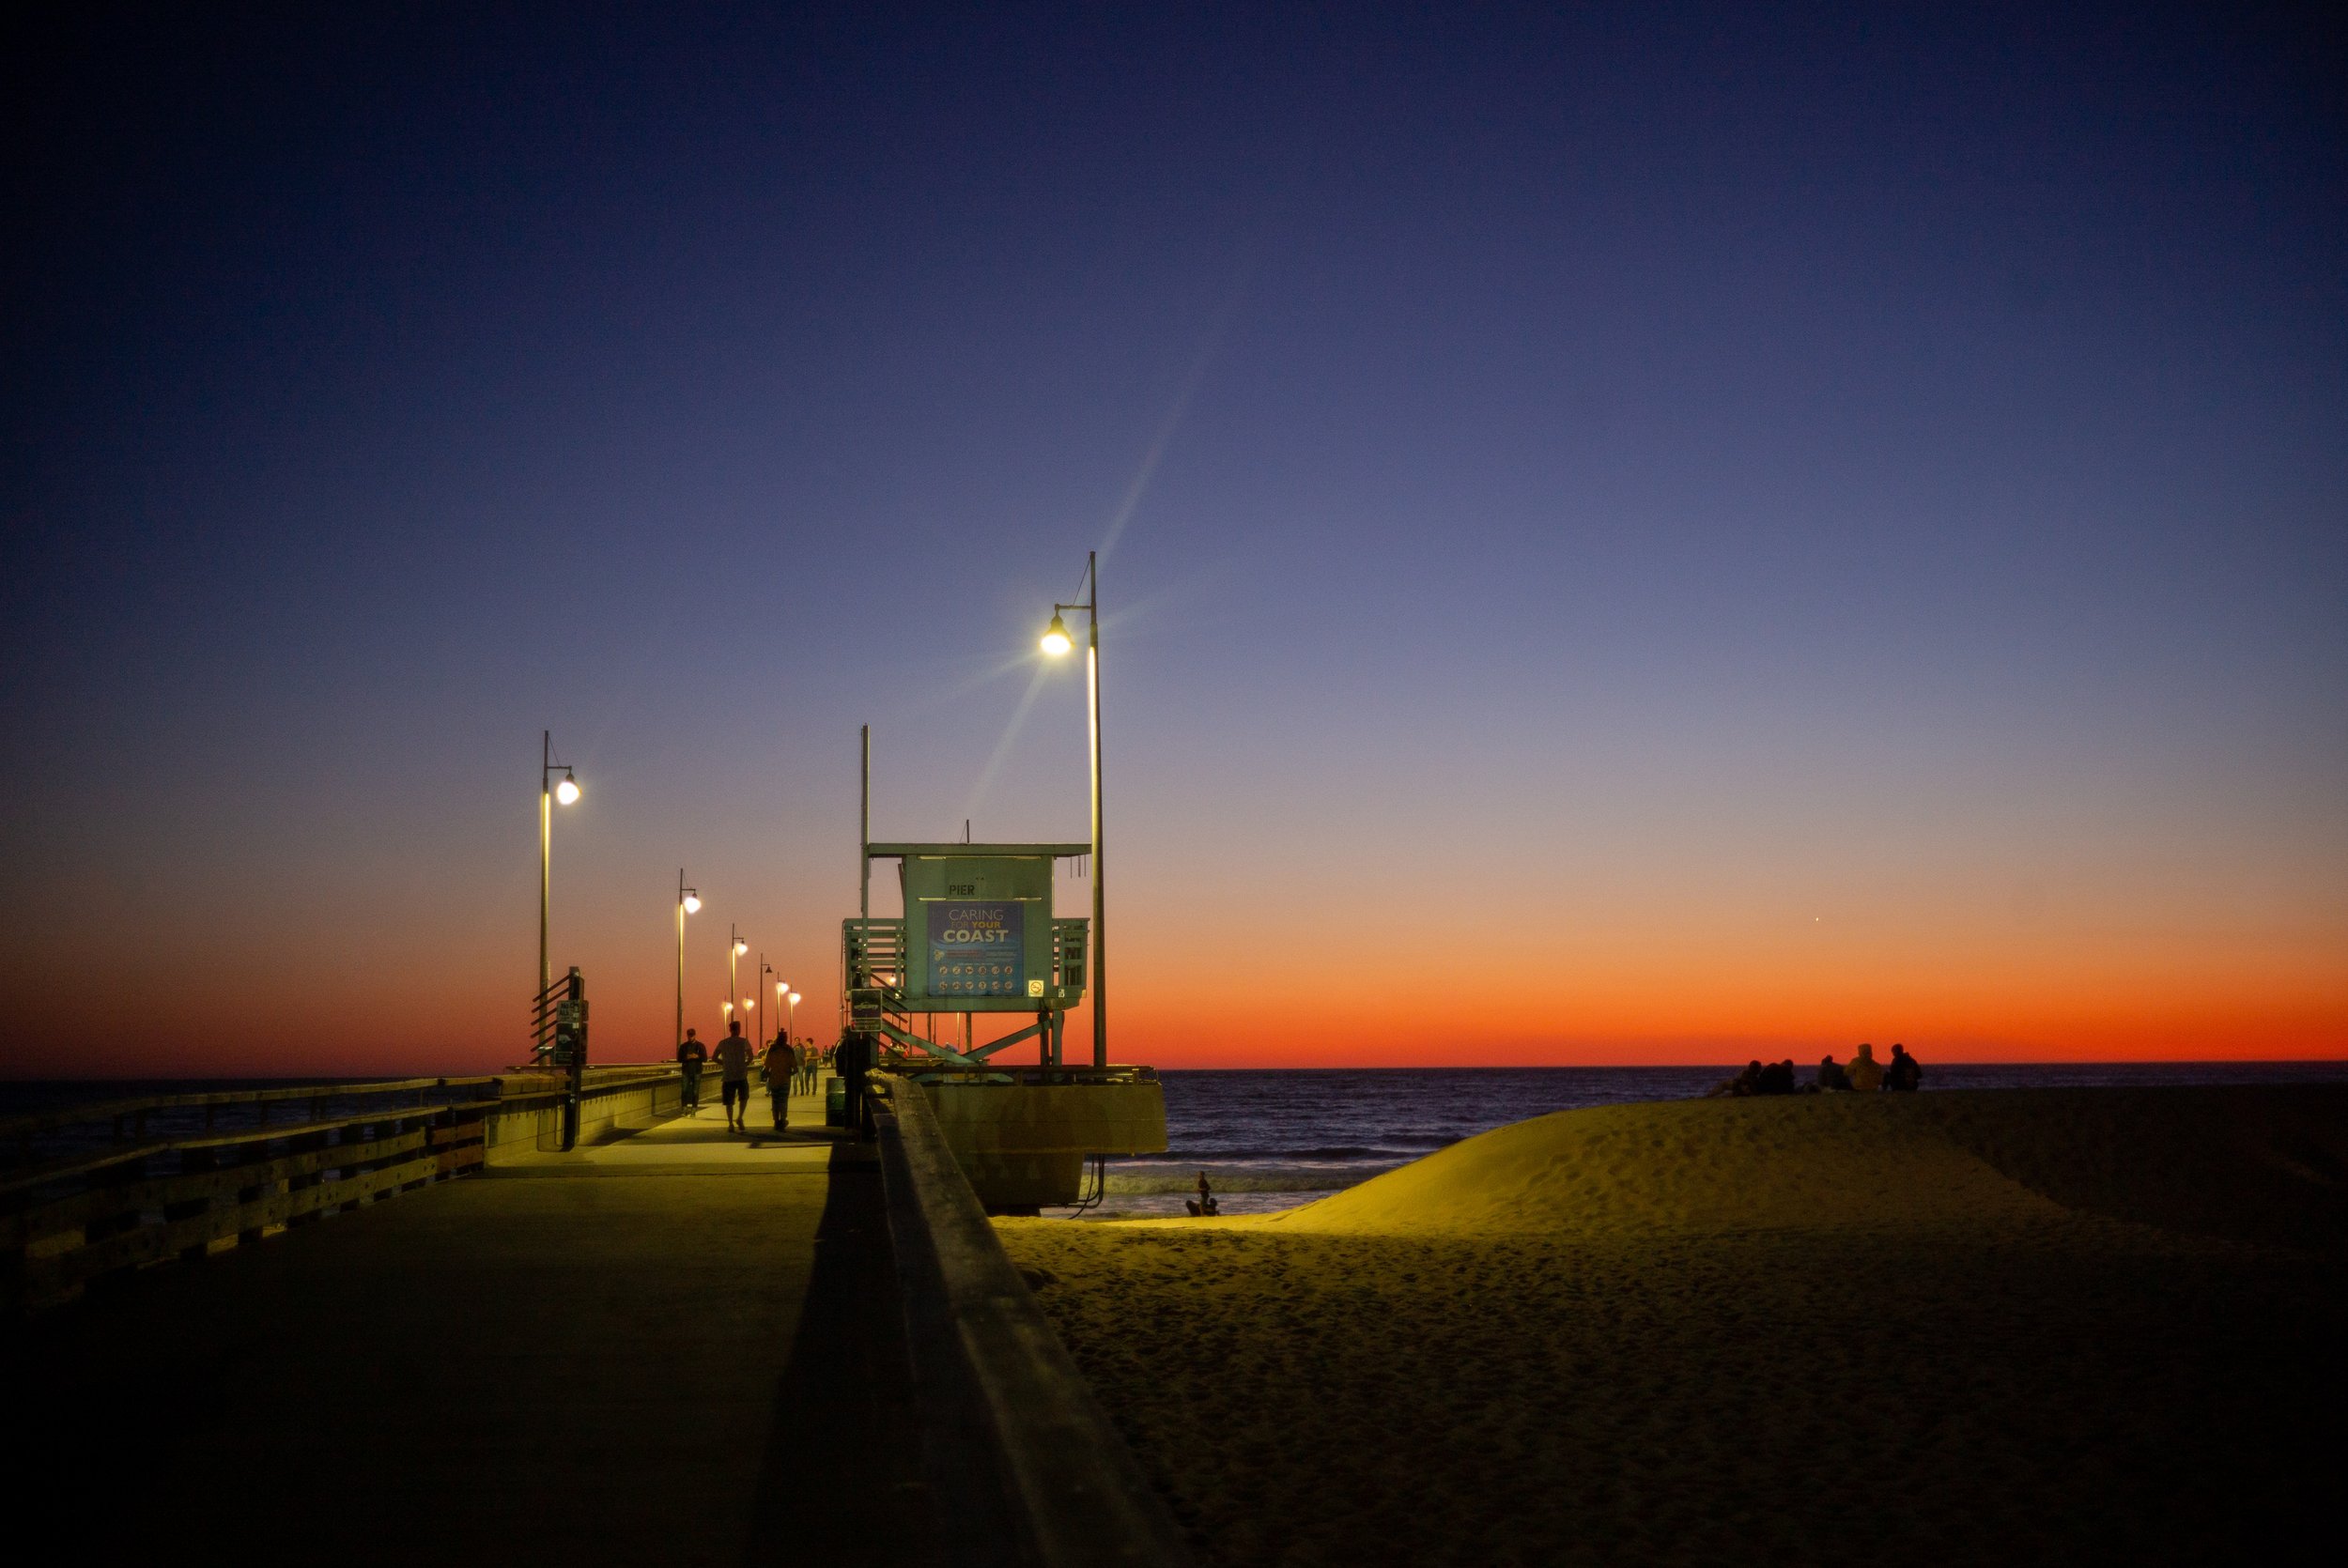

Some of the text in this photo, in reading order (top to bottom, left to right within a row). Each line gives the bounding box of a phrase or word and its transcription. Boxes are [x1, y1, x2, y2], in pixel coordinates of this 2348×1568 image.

[949, 884, 975, 896] PIER
[949, 909, 1004, 921] CARING
[943, 930, 1009, 943] COAST
